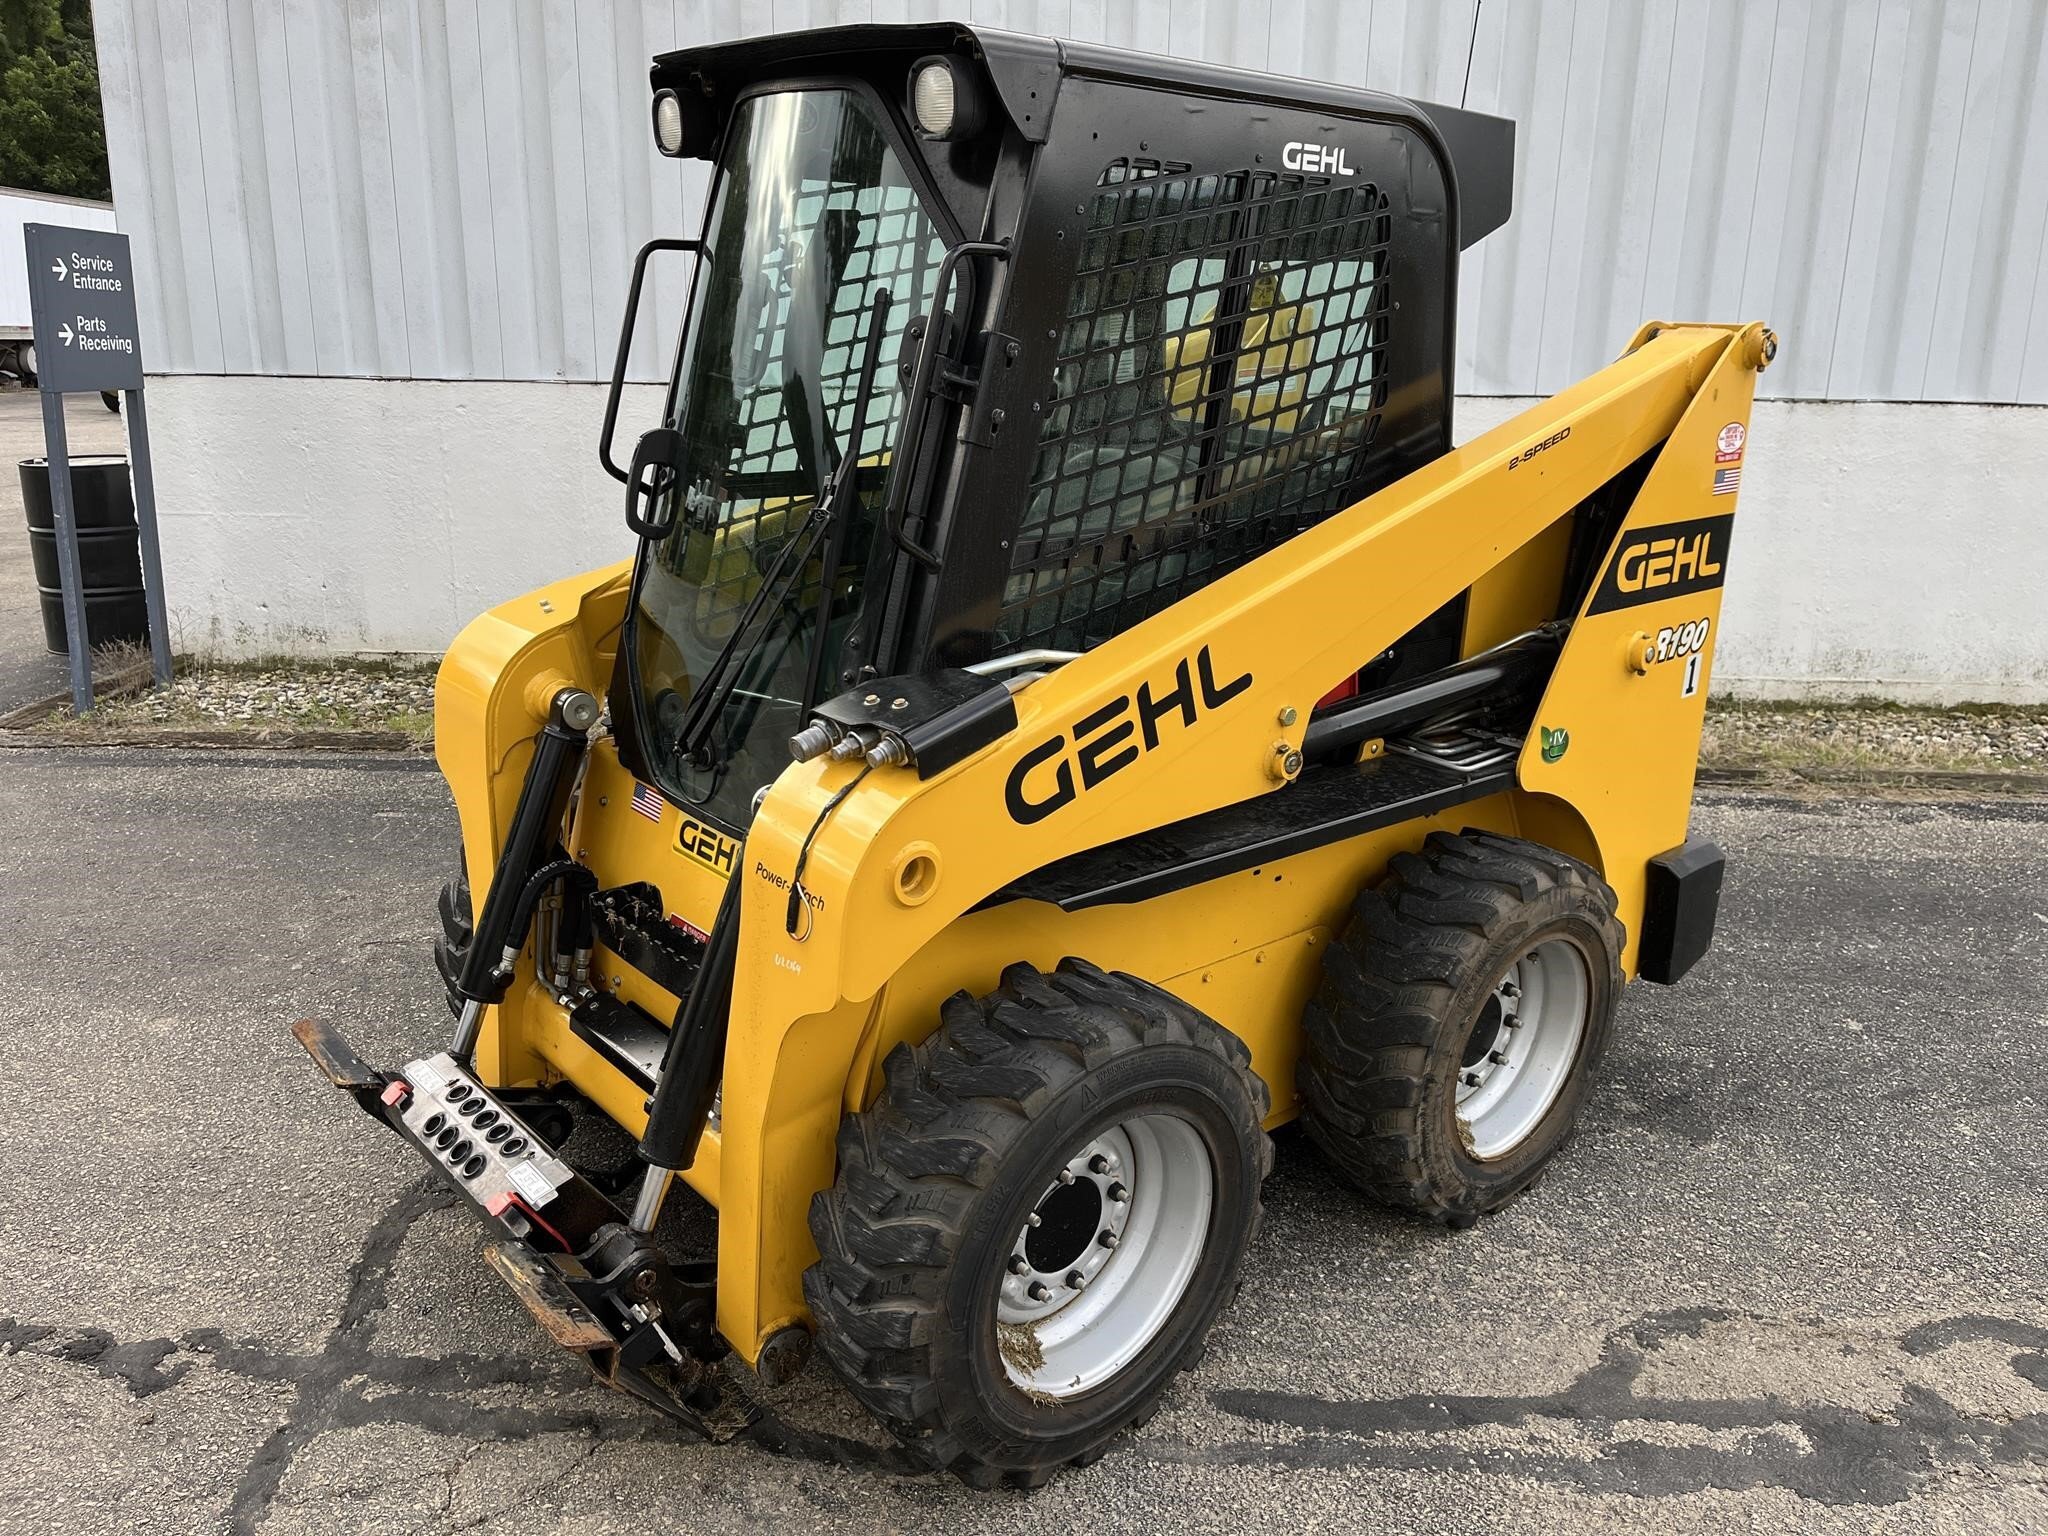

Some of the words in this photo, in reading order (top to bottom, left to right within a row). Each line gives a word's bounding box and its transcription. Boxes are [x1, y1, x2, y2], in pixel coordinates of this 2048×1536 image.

[1282, 141, 1355, 176] GEHL
[71, 252, 114, 272] Service
[73, 273, 122, 292] Entrance
[77, 316, 107, 332] Parts
[79, 335, 133, 354] Receiving
[1508, 426, 1571, 471] 2-SPEED
[1616, 531, 1721, 593] GEHL
[1656, 617, 1710, 664] R190
[1685, 656, 1697, 695] 1
[1005, 643, 1253, 825] GEHL
[679, 819, 738, 873] GEH
